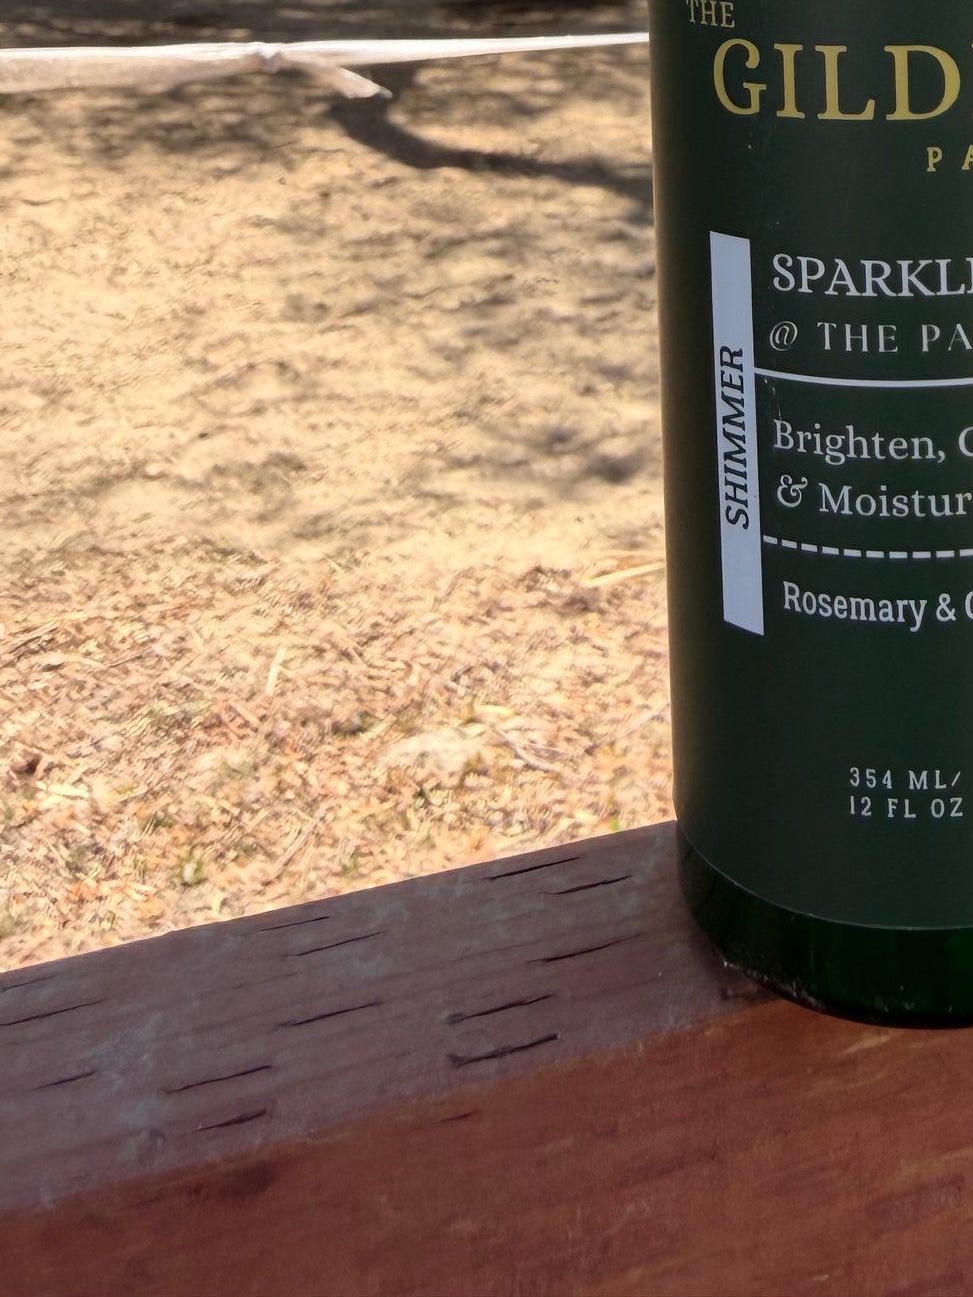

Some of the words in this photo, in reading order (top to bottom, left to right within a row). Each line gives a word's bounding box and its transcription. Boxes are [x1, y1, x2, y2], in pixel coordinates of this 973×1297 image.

[770, 321, 797, 351] @
[817, 322, 897, 352] THE
[721, 346, 749, 529] SHIMMER
[774, 419, 945, 465] Brighten,
[777, 475, 808, 507] &
[783, 581, 927, 632] Rosemary
[936, 594, 956, 621] &
[850, 767, 892, 789] 354
[909, 770, 960, 789] ML/
[851, 796, 871, 816] 12
[888, 798, 916, 818] FL
[931, 798, 963, 818] OZ
